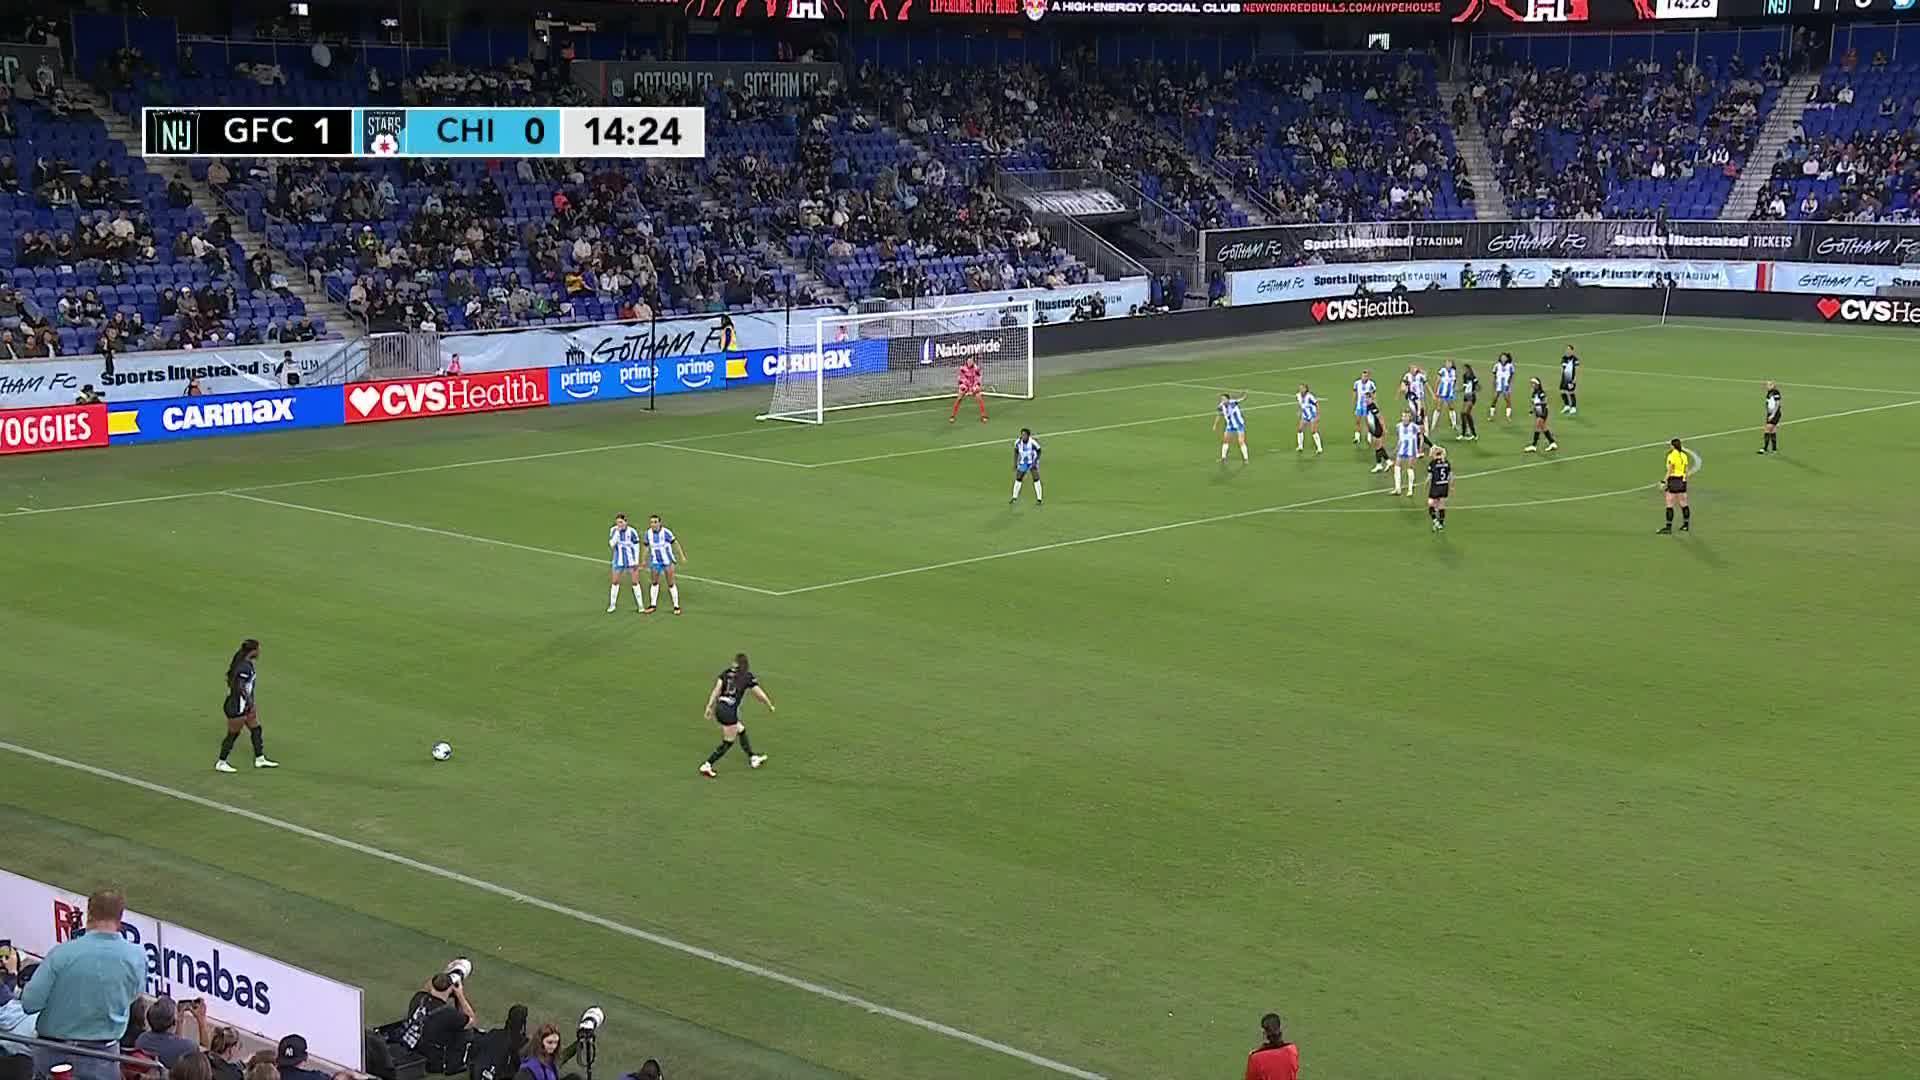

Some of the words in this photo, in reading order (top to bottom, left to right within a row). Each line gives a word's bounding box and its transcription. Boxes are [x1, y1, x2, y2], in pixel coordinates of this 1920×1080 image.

[1051, 2, 1062, 12] A
[1063, 2, 1143, 13] HIGH-ENERGY
[1148, 2, 1200, 13] SOCIAL
[1202, 3, 1241, 13] CLUB
[1243, 2, 1441, 14] NEWYORKREDBULLS.COM/HYPEHOUSE
[1303, 237, 1348, 250] Sports
[1349, 235, 1414, 249] Illustrated
[1416, 236, 1463, 247] STADIUM
[1487, 229, 1558, 252] GOTHAM
[1560, 233, 1587, 249] FC
[1614, 234, 1667, 247] Sports
[1668, 233, 1750, 247] Illustrated
[1752, 235, 1793, 248] TICKETS
[1817, 237, 1891, 255] GOTHAM
[1217, 241, 1264, 262] GOTHAM
[1265, 240, 1282, 256] FC
[1257, 279, 1291, 293] GOTHAM
[1292, 277, 1304, 289] FC
[1314, 274, 1348, 286] Sports
[1407, 272, 1447, 281] STADIUM
[1673, 272, 1720, 281] STADIUM
[1798, 274, 1853, 288] GOTHAM
[1855, 275, 1876, 288] FC
[591, 330, 695, 364] GOTHAM
[700, 326, 723, 354] F
[935, 338, 1001, 359] Nationwide
[101, 368, 167, 387] Sports
[167, 361, 260, 382] Illustrated
[620, 363, 659, 384] prime
[677, 358, 714, 379] prime
[49, 373, 77, 390] FC
[561, 368, 601, 388] prime
[0, 412, 91, 448] OGGIES
[1440, 468, 1446, 480] 5
